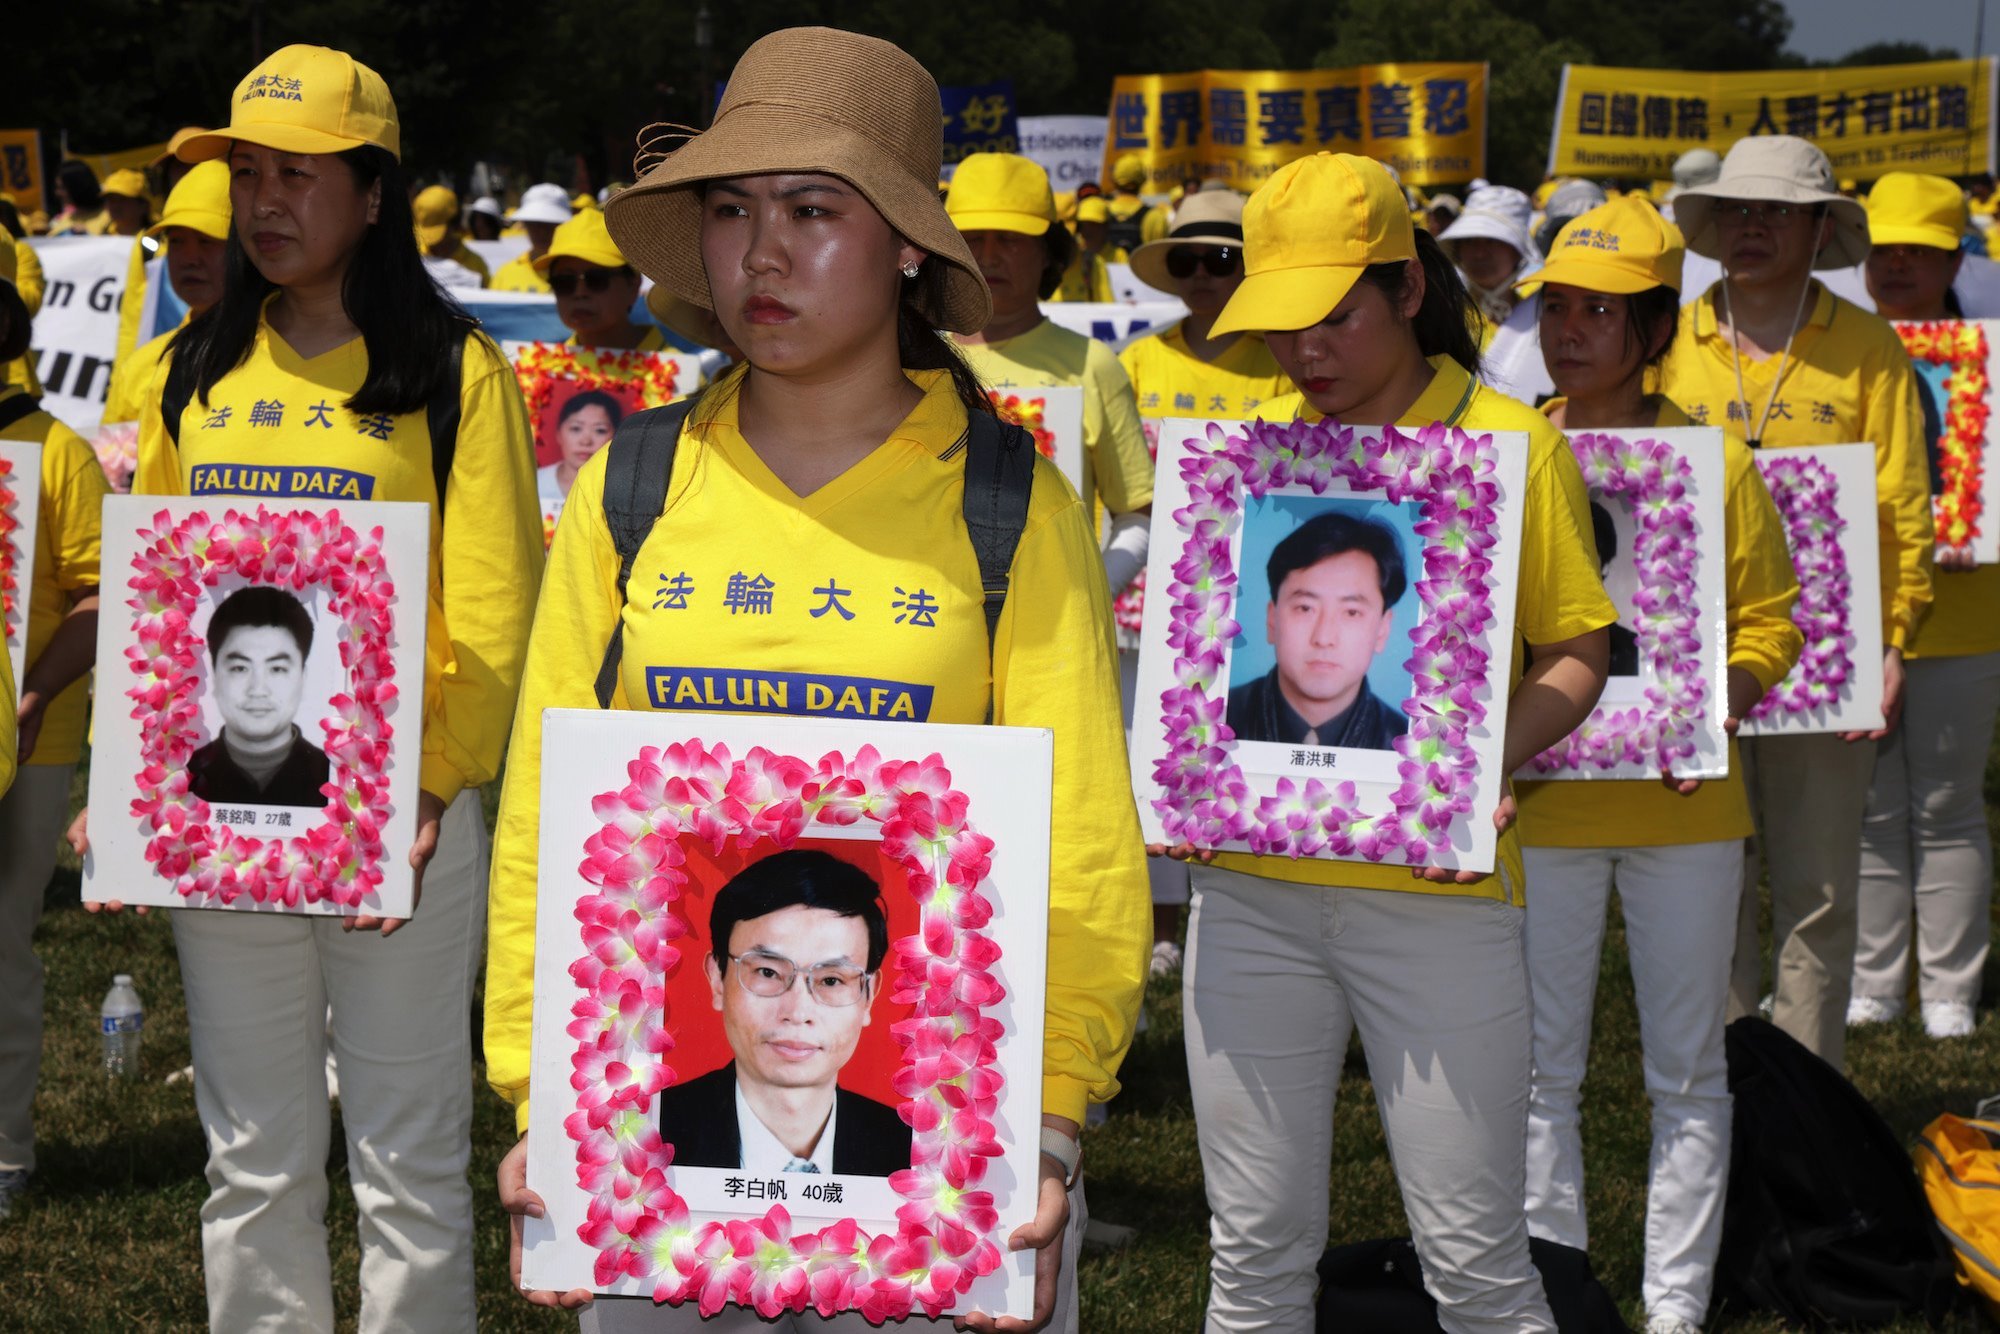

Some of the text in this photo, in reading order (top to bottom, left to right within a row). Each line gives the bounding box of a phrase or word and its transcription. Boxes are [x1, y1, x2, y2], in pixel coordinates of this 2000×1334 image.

[269, 88, 303, 102] DAFA
[1114, 80, 1470, 149] 世界需要真善忍
[201, 399, 395, 441] 法輪大法
[194, 468, 361, 500] FALUN DAFA
[652, 571, 940, 628] 法輪大法
[654, 675, 916, 719] FALUN DAFA
[1290, 749, 1337, 769] 潘洪東
[215, 808, 256, 826] 蔡銘陶
[724, 1176, 844, 1204] 李白帆 40歲
